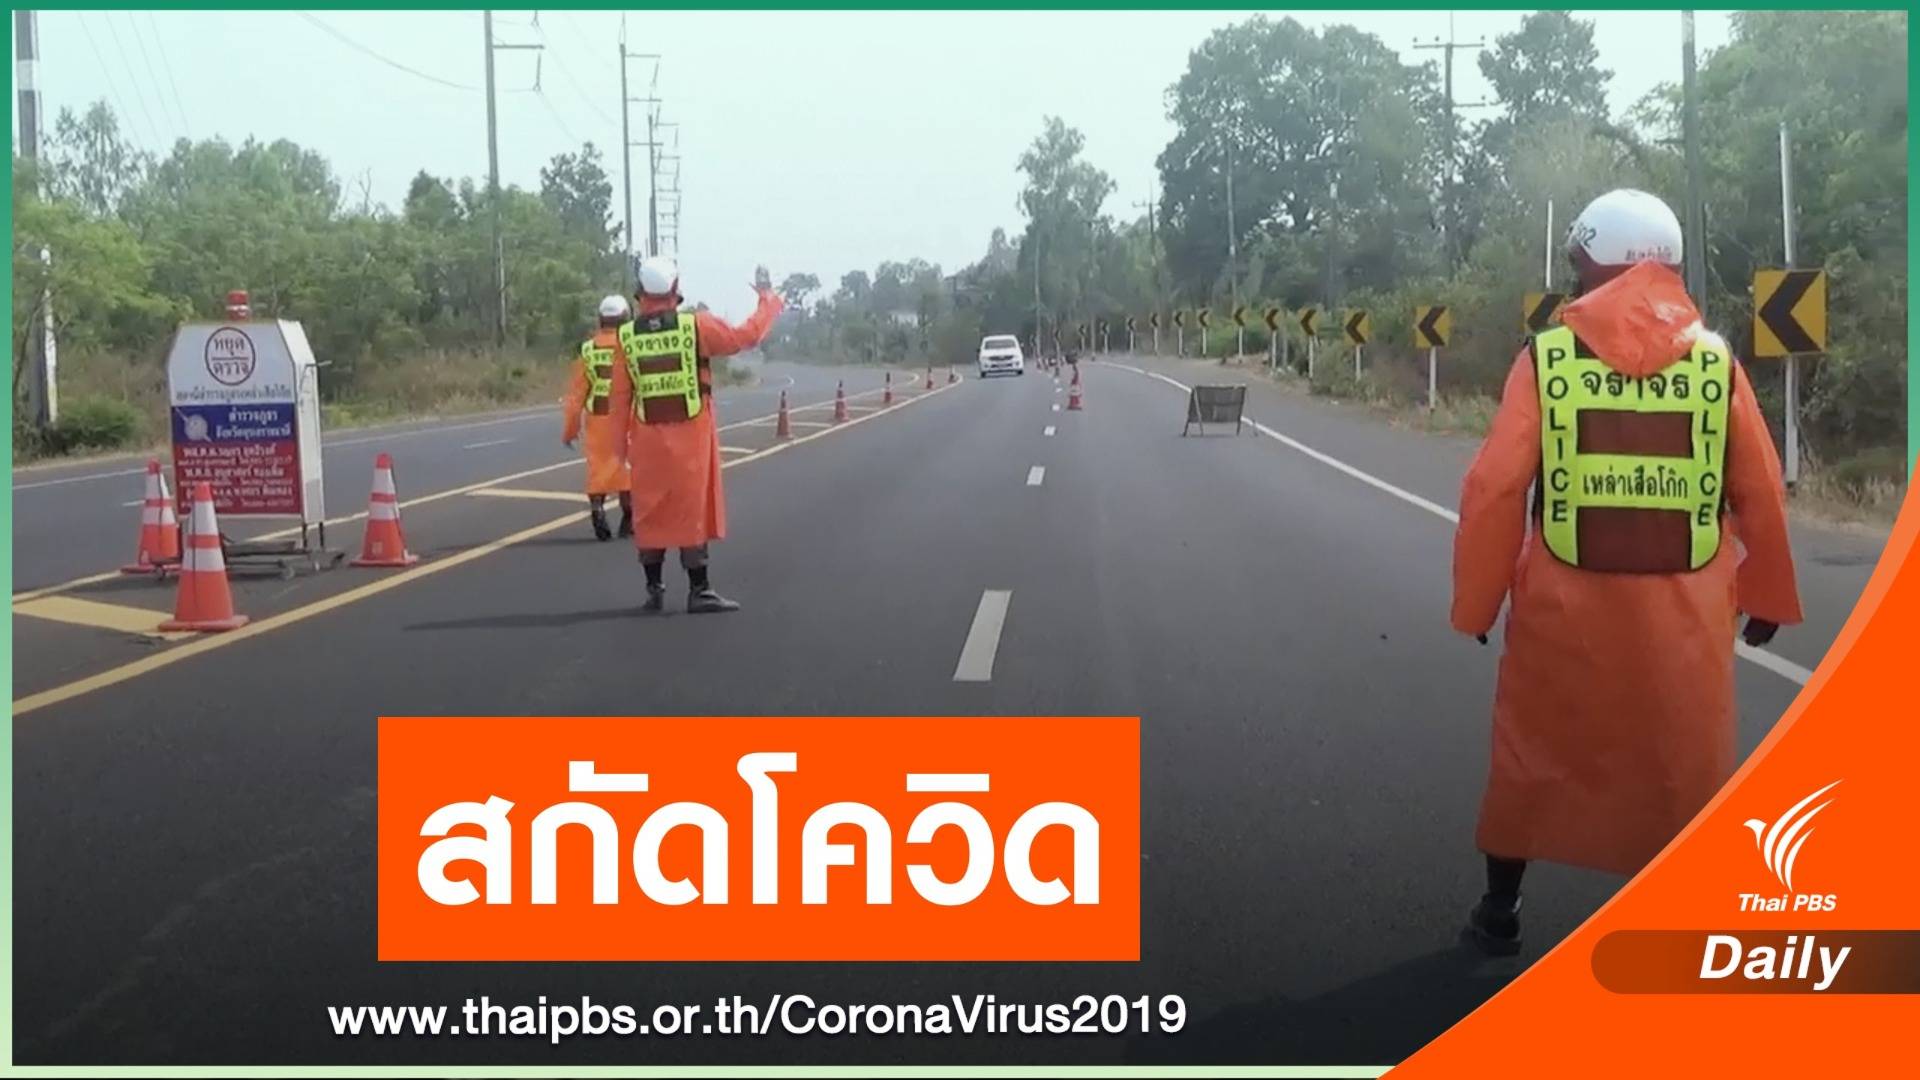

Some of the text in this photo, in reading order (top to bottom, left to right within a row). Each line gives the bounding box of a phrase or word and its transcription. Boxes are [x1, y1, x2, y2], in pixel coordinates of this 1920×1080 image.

[1545, 347, 1569, 523] POLICE
[1580, 369, 1691, 400] จราจร
[1696, 350, 1722, 527] POLICE
